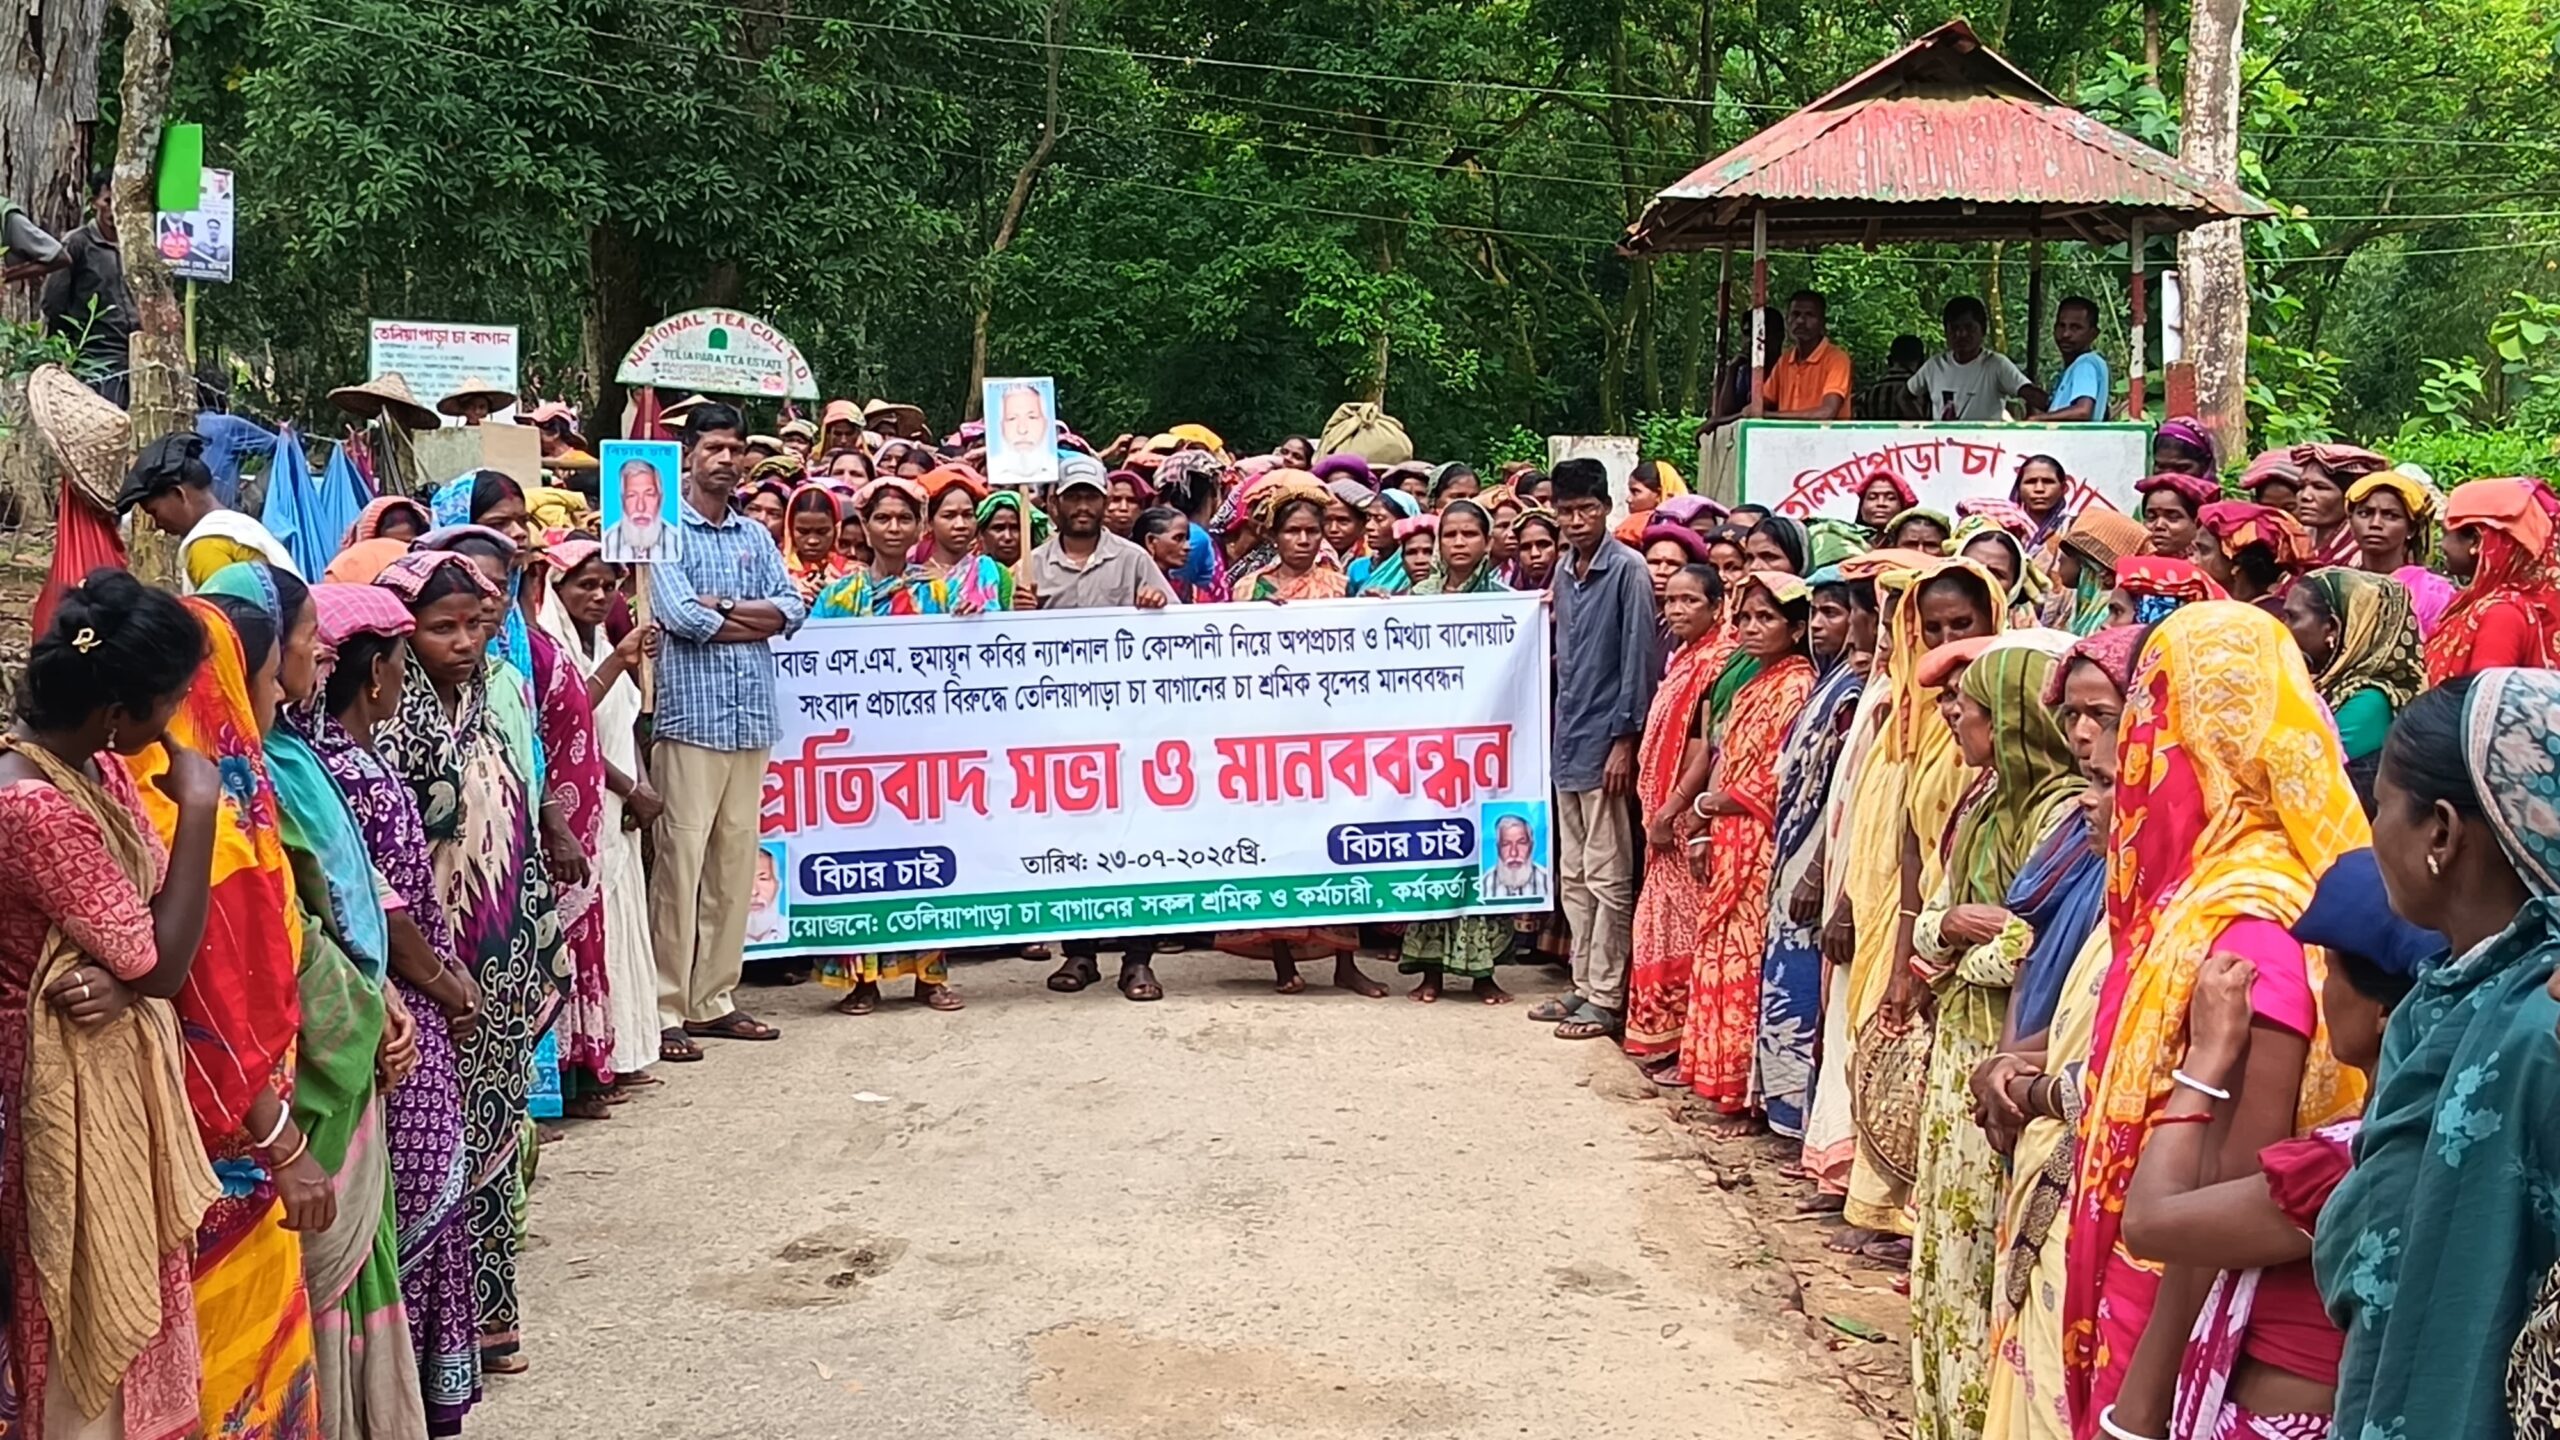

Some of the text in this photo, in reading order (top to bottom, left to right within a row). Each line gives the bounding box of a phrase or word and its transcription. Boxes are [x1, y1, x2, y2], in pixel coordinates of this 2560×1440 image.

[628, 314, 705, 367] NATIONAL
[712, 312, 745, 329] TEA
[1946, 436, 2006, 478] চা
[908, 644, 972, 679] হুমায়ূন
[977, 633, 1026, 669] কবির
[1032, 638, 1108, 667] ন্যাশনাল
[1114, 628, 1135, 662] টি
[1142, 623, 1224, 661] কোম্পানী
[1229, 623, 1272, 658] নিয়ে
[1277, 628, 1355, 655] অপপ্রচার
[1362, 627, 1378, 650] ও
[1384, 617, 1431, 651] মিথ্যা
[1437, 614, 1517, 648] বানোয়াট
[798, 664, 1464, 722] সংবাদ প্রচারের বিরুদ্ধে তেলিয়াপাড়া চা বাগানের চা শ্রমিক বৃন্দের মানববন্ধন
[759, 723, 1513, 834] প্রতিবাদ সভা ও মানববন্ধন
[1338, 821, 1466, 862] বিচার চাই
[811, 850, 945, 892] বিচার চাই
[886, 902, 1013, 933] তেলিয়াপাড়া
[1017, 901, 1042, 925] চা
[1047, 897, 1134, 923] বাগানের
[1139, 893, 1196, 916] সকল
[1201, 883, 1263, 914] শ্রমিক
[1269, 889, 1288, 908] ও
[1388, 871, 1468, 903] কর্মকর্তা
